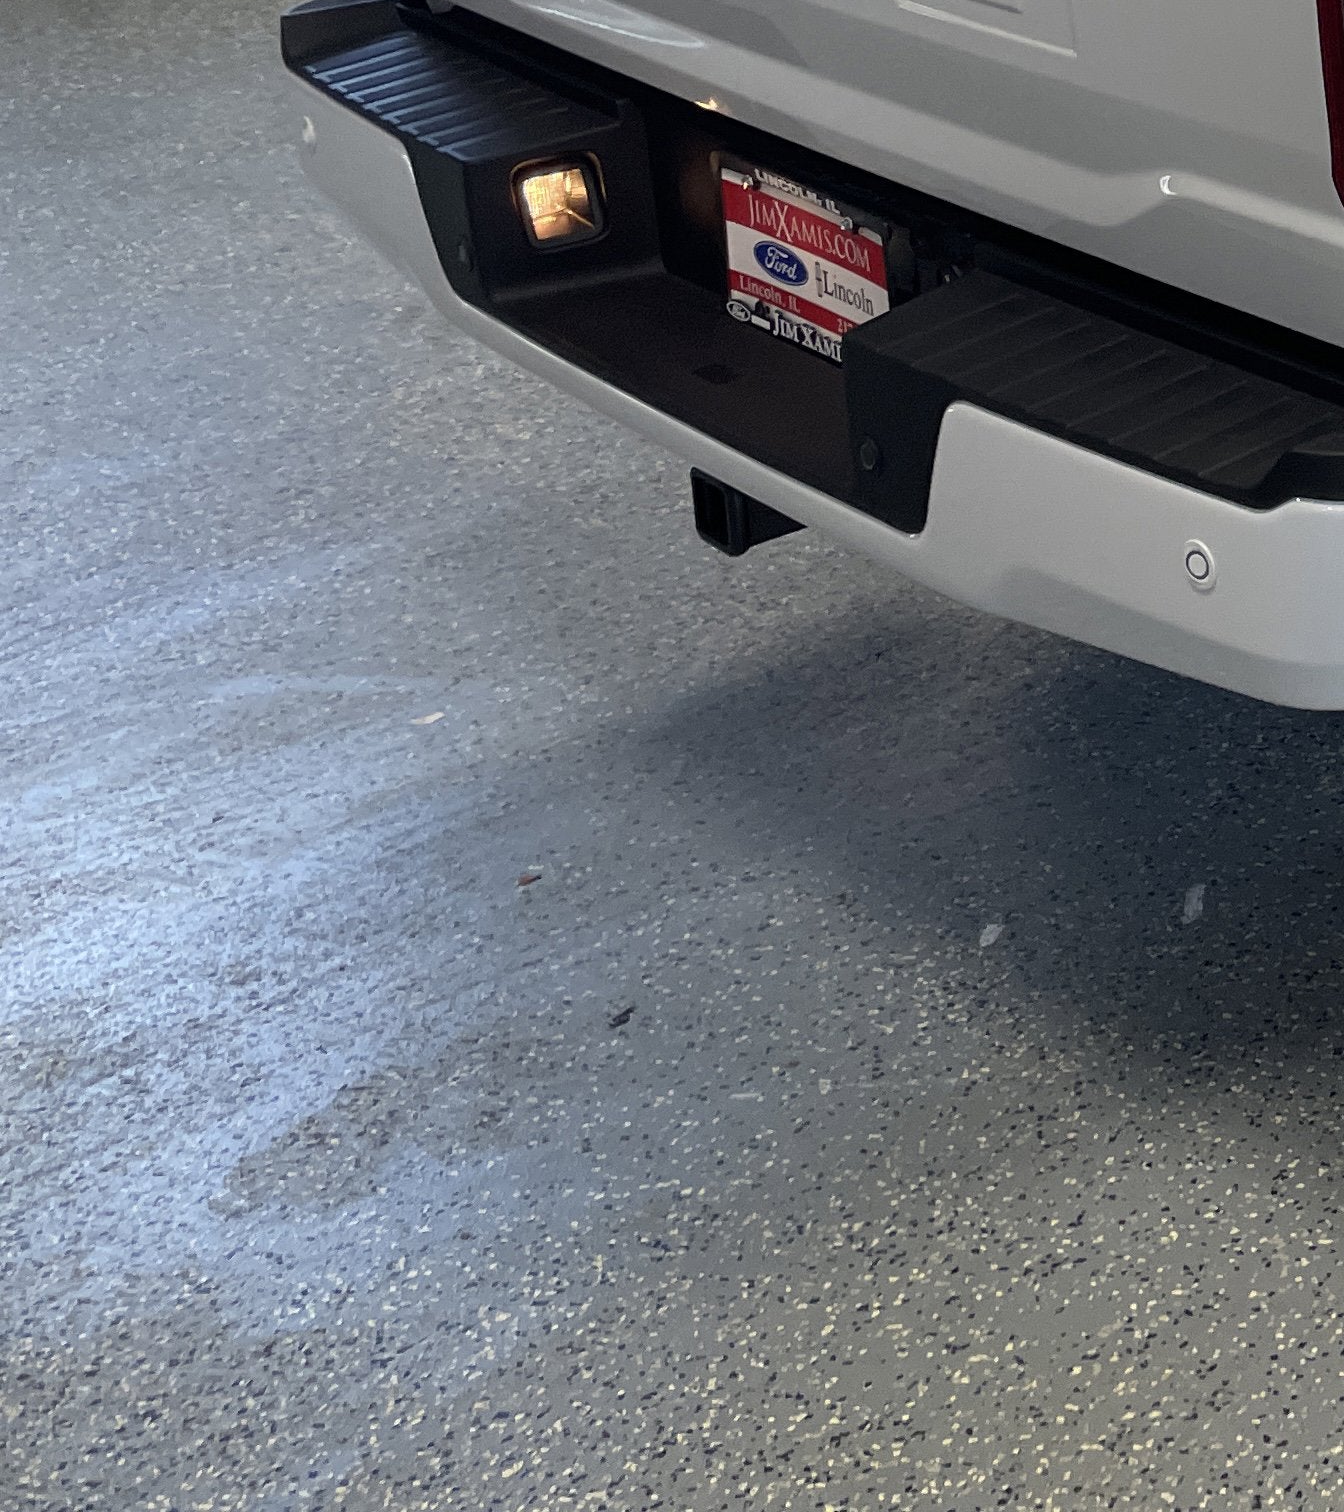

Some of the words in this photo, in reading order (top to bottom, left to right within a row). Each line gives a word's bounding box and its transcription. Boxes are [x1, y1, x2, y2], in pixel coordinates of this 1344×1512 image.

[764, 246, 797, 280] Ford
[822, 269, 874, 317] Lincoln
[773, 312, 800, 343] JIM
[800, 324, 842, 363] XAMI
